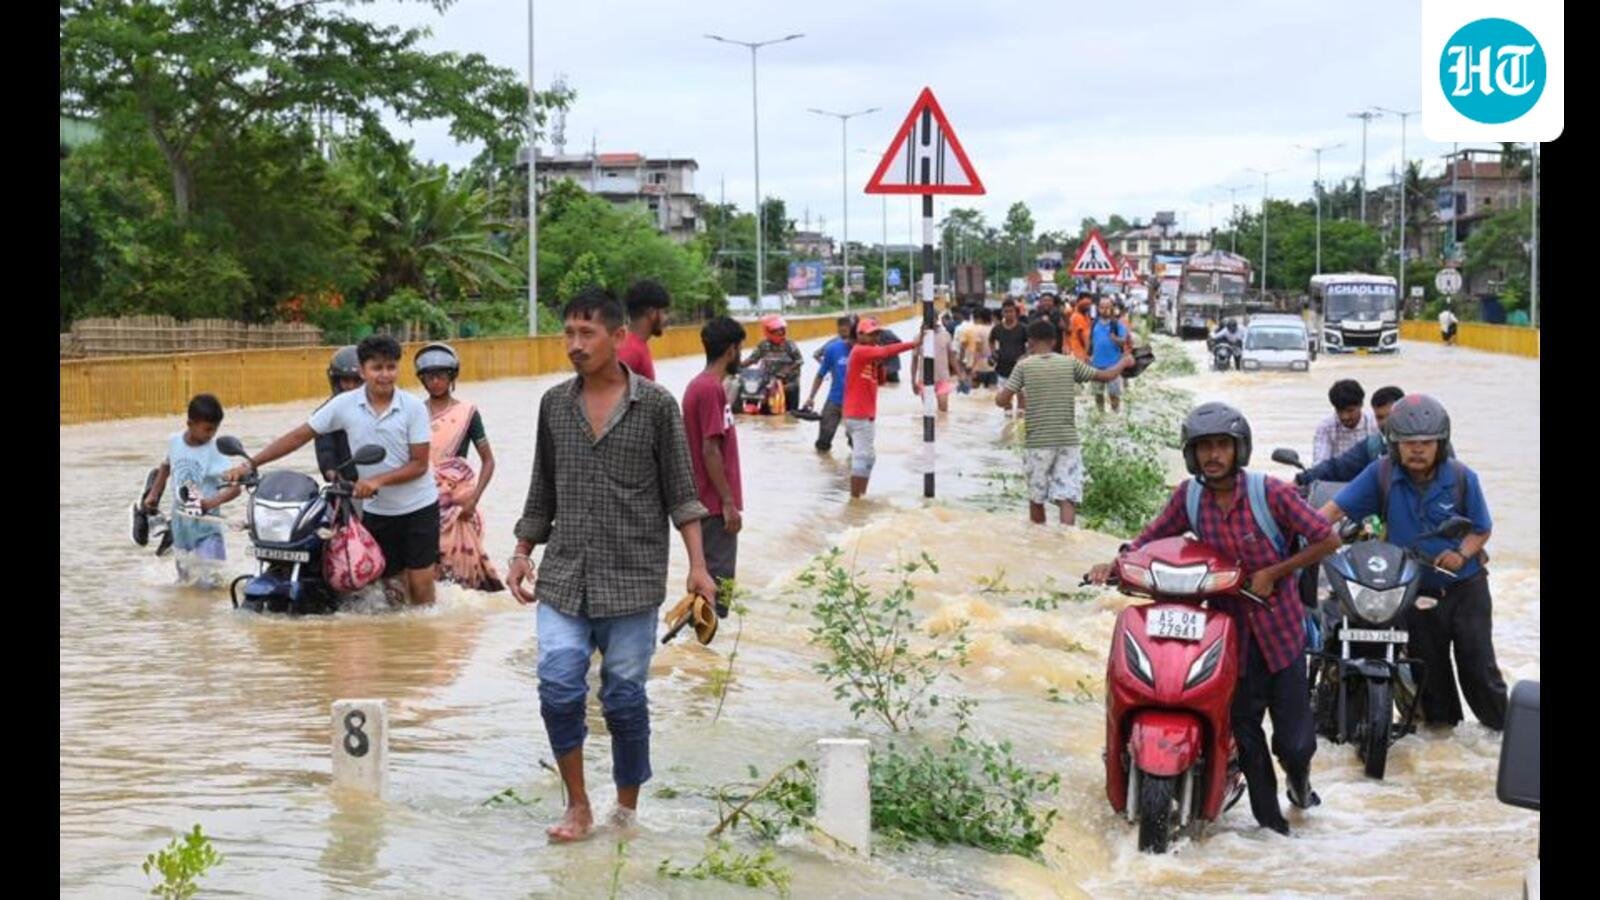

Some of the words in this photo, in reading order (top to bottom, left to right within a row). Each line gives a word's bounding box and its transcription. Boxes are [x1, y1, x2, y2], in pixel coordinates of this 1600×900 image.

[1159, 611, 1175, 623] AS
[1181, 613, 1197, 625] 04
[343, 709, 370, 758] 8
